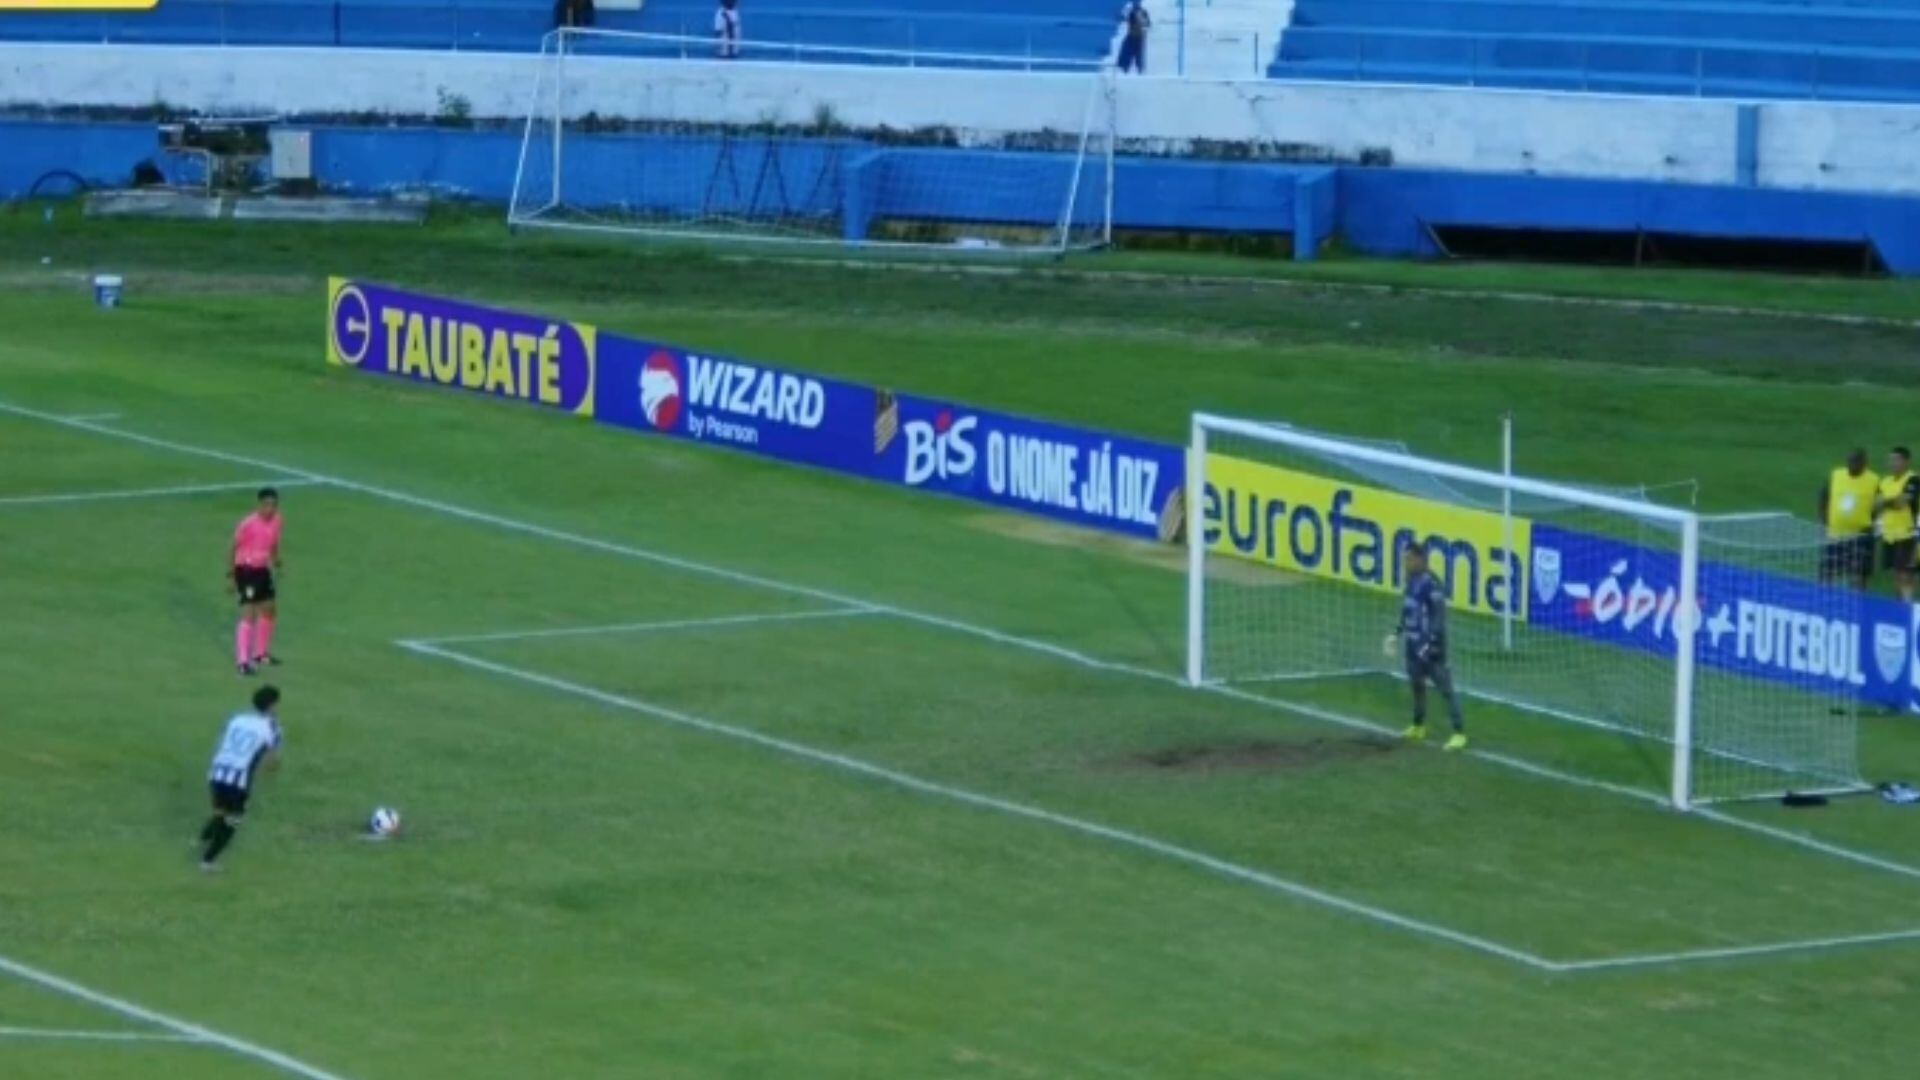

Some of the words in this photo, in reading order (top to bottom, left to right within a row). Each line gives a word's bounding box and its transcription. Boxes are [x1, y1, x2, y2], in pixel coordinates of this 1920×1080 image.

[382, 305, 560, 403] TAUBATÉ
[686, 355, 825, 429] WIZARD
[688, 410, 705, 438] by
[706, 415, 759, 444] Pearson
[987, 430, 1006, 494] O
[1009, 434, 1079, 509] NOME
[1081, 440, 1113, 517] JÁ
[1117, 454, 1159, 525] DIZ
[1203, 481, 1520, 614] eurofarma
